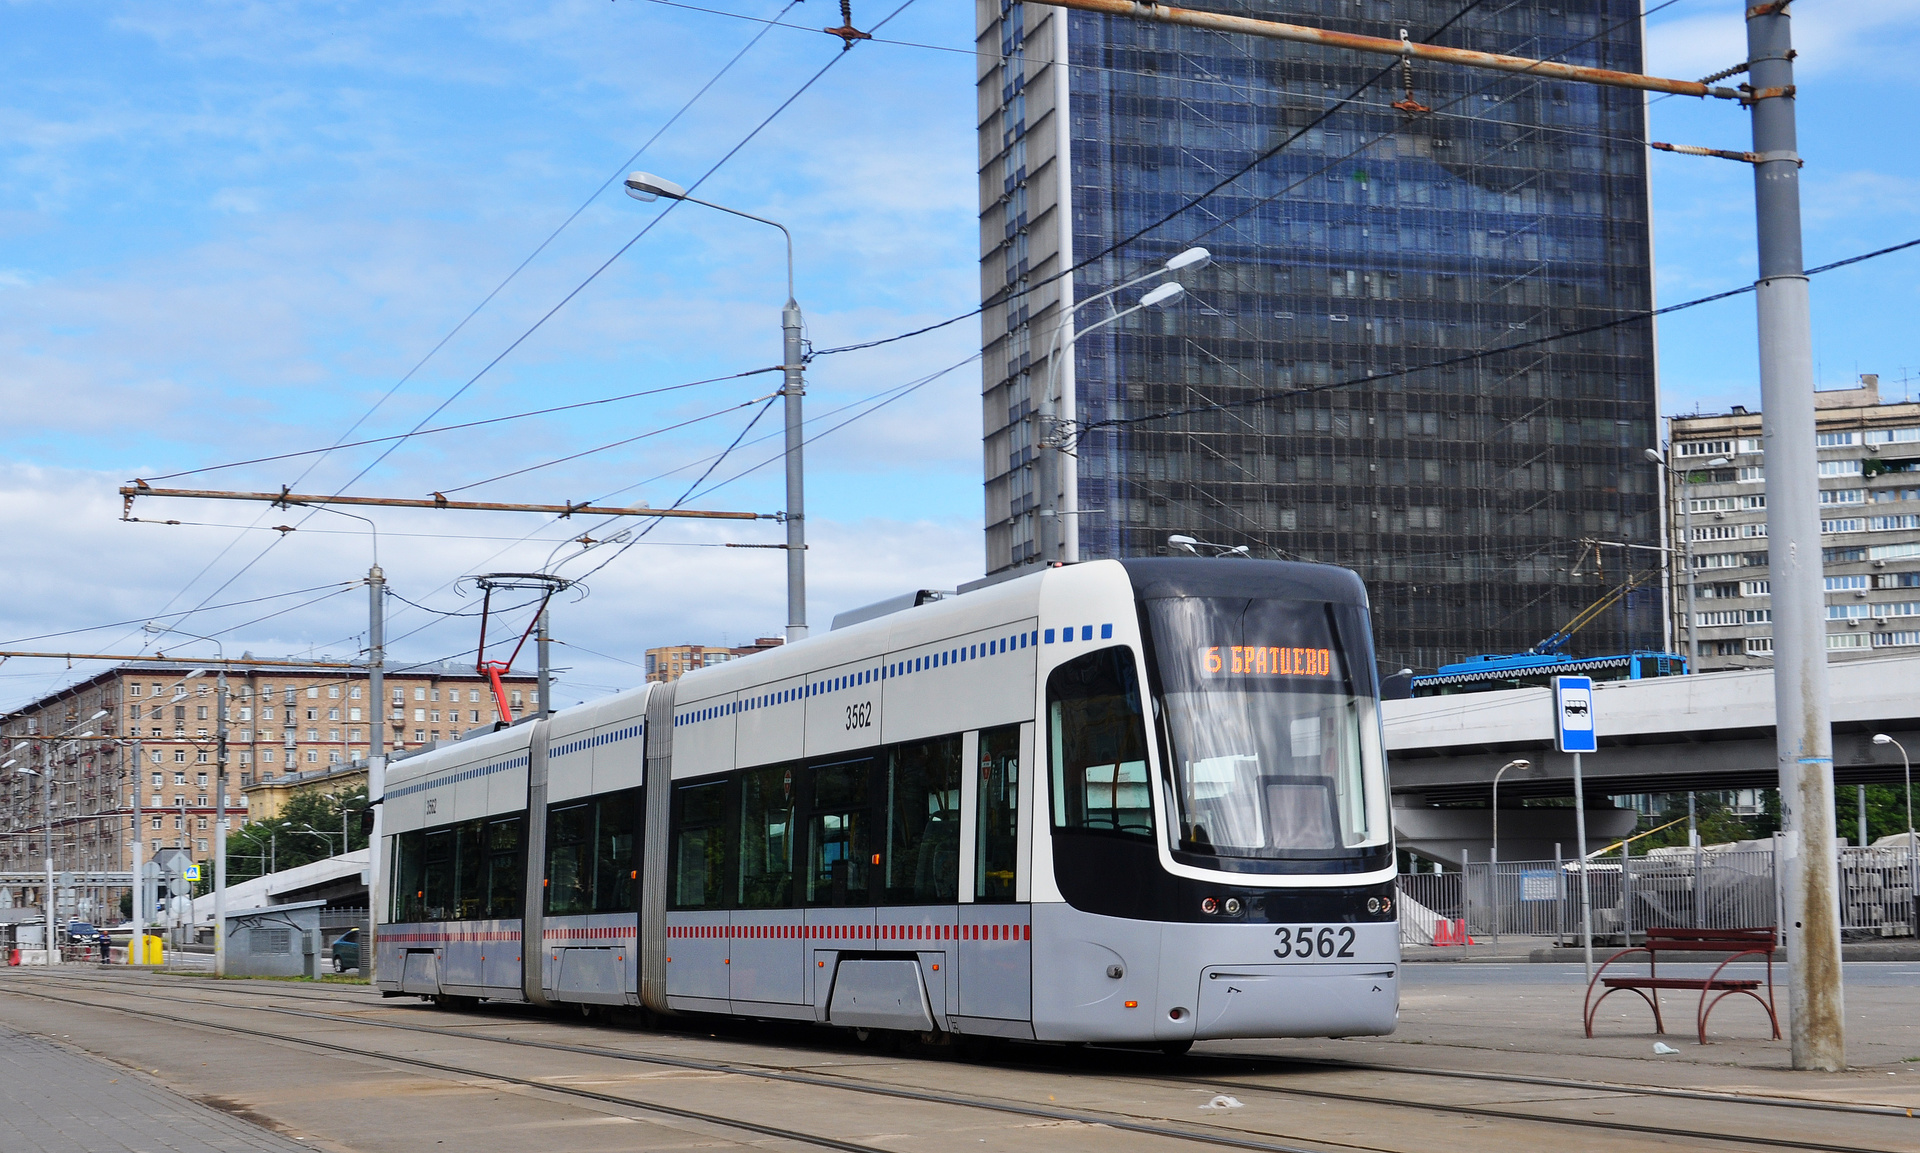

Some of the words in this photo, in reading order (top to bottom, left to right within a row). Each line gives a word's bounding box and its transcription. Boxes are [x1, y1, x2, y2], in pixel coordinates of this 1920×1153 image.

[1203, 646, 1222, 673] 6
[1230, 646, 1330, 676] БРАТЦЕВО
[845, 701, 872, 731] 3562
[426, 798, 437, 815] 3562
[1273, 926, 1356, 958] 3562
